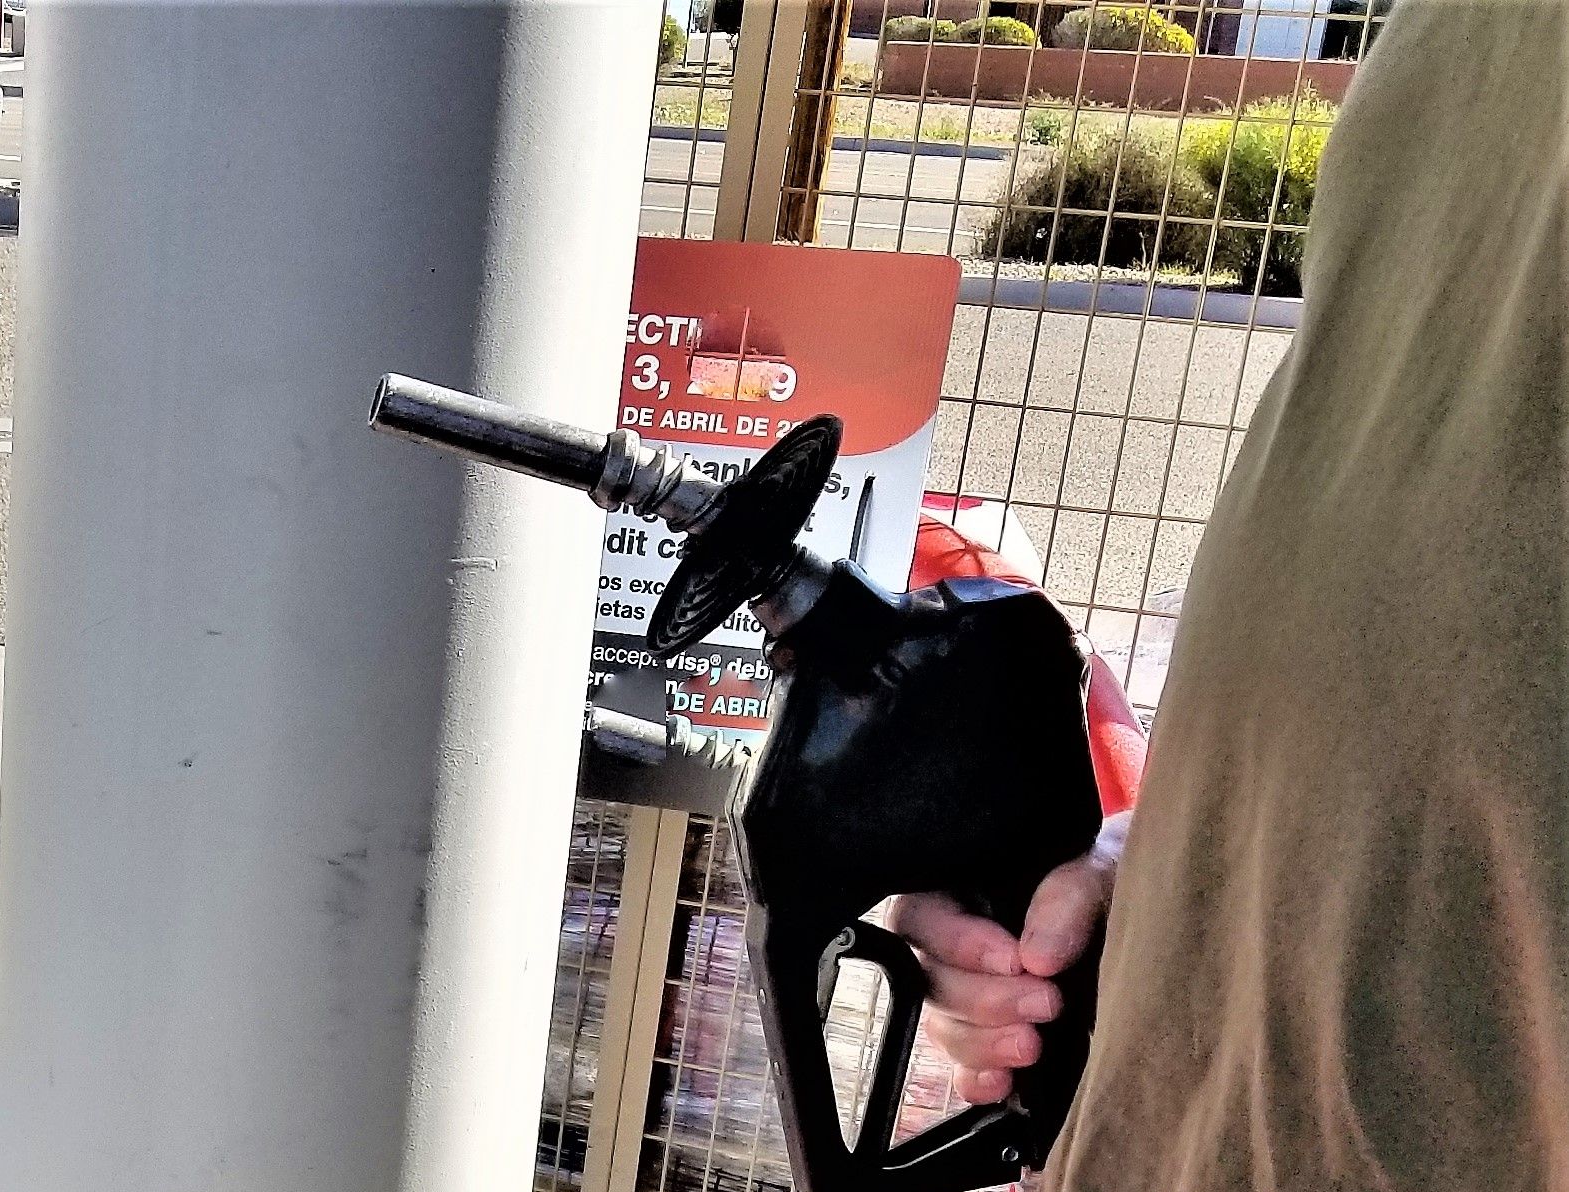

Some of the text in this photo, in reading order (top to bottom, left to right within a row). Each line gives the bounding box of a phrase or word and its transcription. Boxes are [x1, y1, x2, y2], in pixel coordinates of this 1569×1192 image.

[622, 407, 654, 427] DE
[660, 410, 729, 434] ABRIL
[736, 417, 770, 437] DE
[606, 528, 648, 556] dit
[598, 575, 666, 596] os exc
[727, 658, 773, 681] deb
[672, 693, 769, 718] DE ABRI
